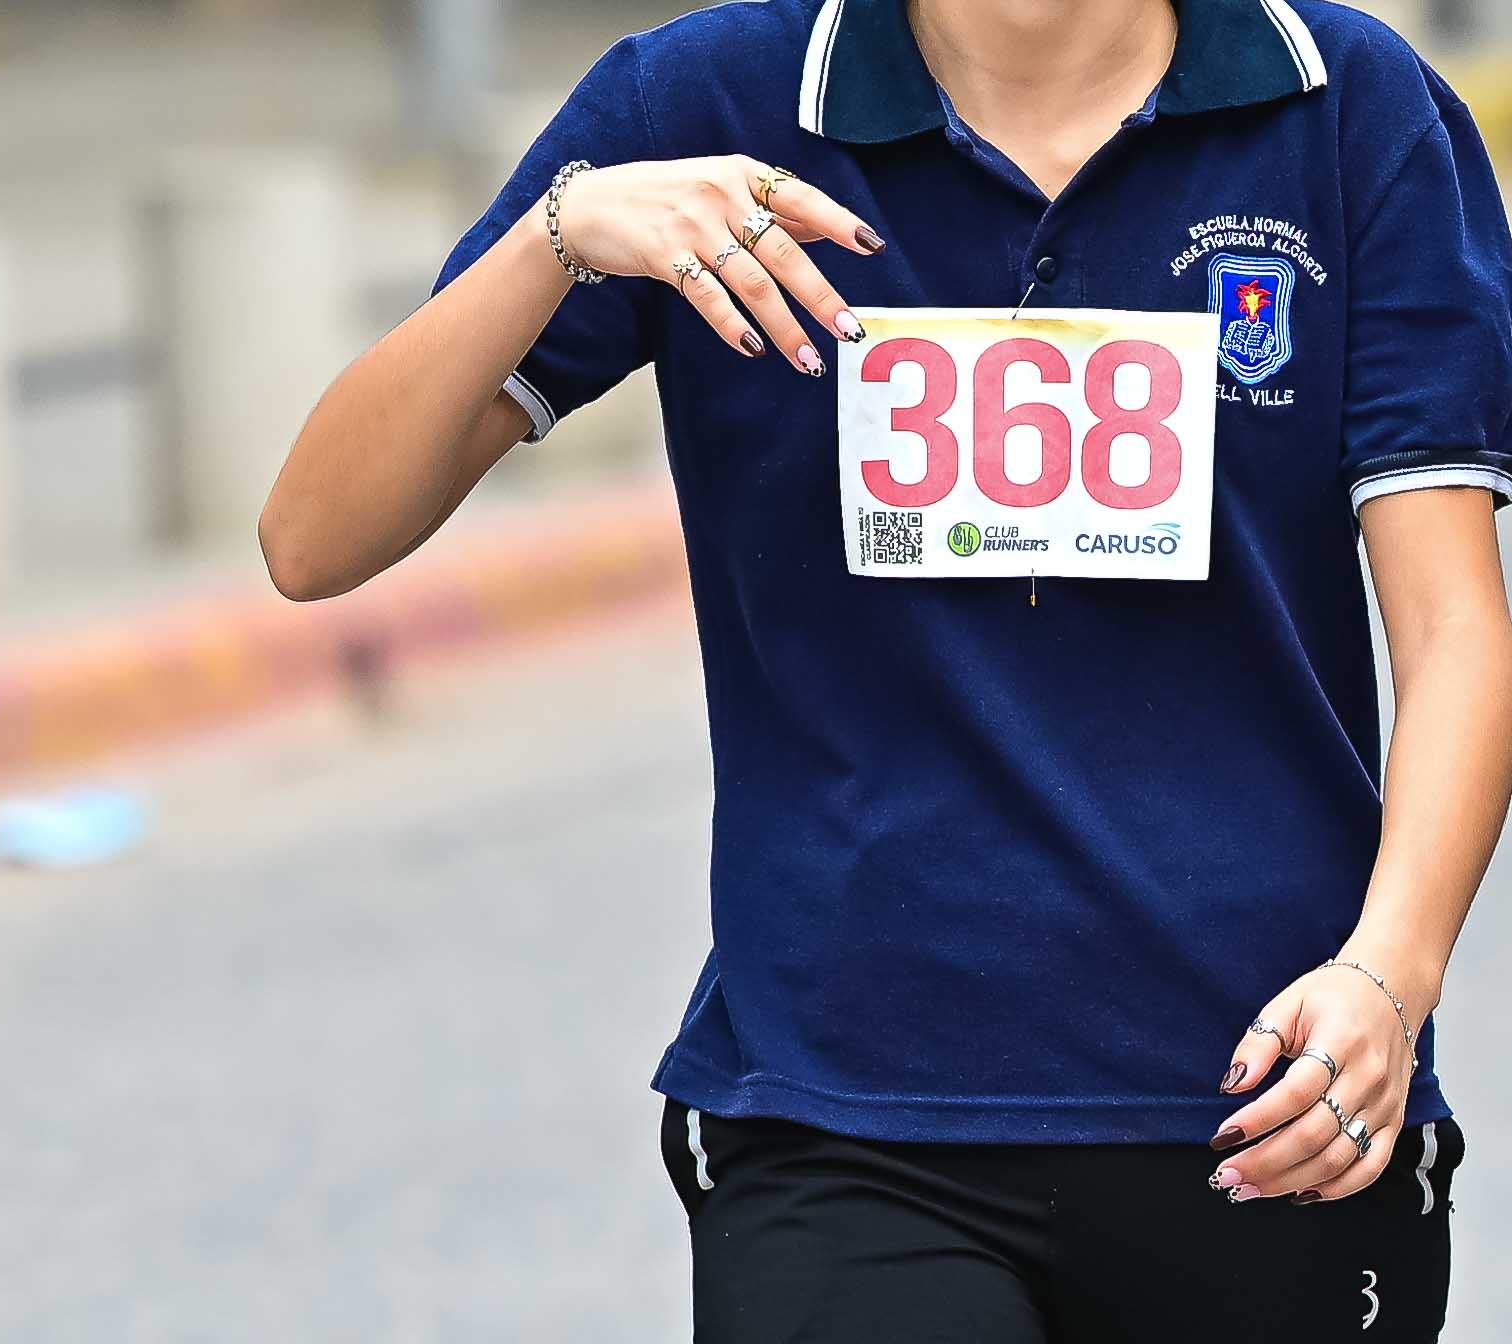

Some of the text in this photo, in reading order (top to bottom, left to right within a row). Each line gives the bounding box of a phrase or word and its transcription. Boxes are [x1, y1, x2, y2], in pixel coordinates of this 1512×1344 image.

[1189, 215, 1308, 248] ESCUELA NORMAL
[1170, 232, 1328, 286] JOSE FIGUEROA ALCORTA
[1249, 389, 1295, 406] VILLE
[861, 337, 1183, 509] 368
[984, 526, 1019, 538] CLUB
[983, 539, 1050, 551] RUNNER'S
[1075, 533, 1178, 555] CARUSO
